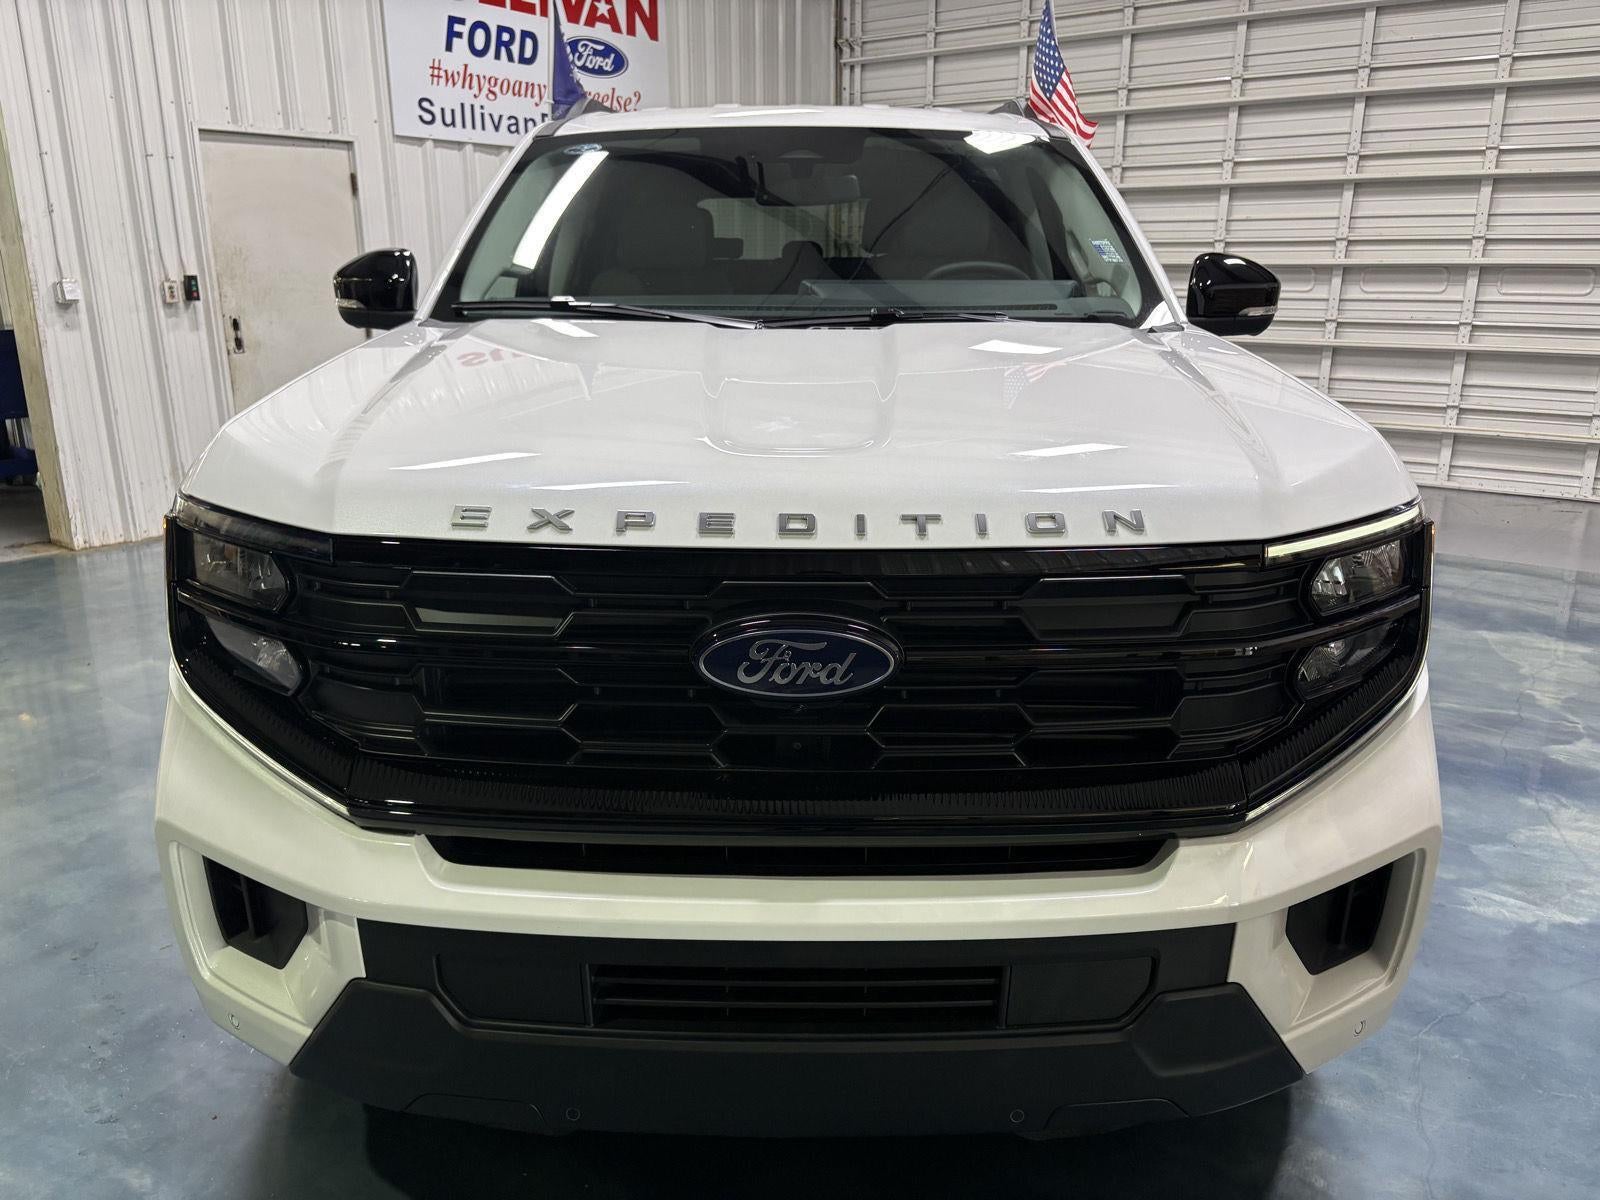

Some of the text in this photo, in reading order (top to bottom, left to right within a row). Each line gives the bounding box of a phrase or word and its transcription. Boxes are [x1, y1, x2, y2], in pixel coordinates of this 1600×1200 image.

[445, 15, 539, 65] FORD
[574, 40, 615, 71] Ford
[418, 97, 548, 135] Sullivan
[450, 503, 1145, 537] EXPEDITION
[737, 639, 856, 685] Ford
